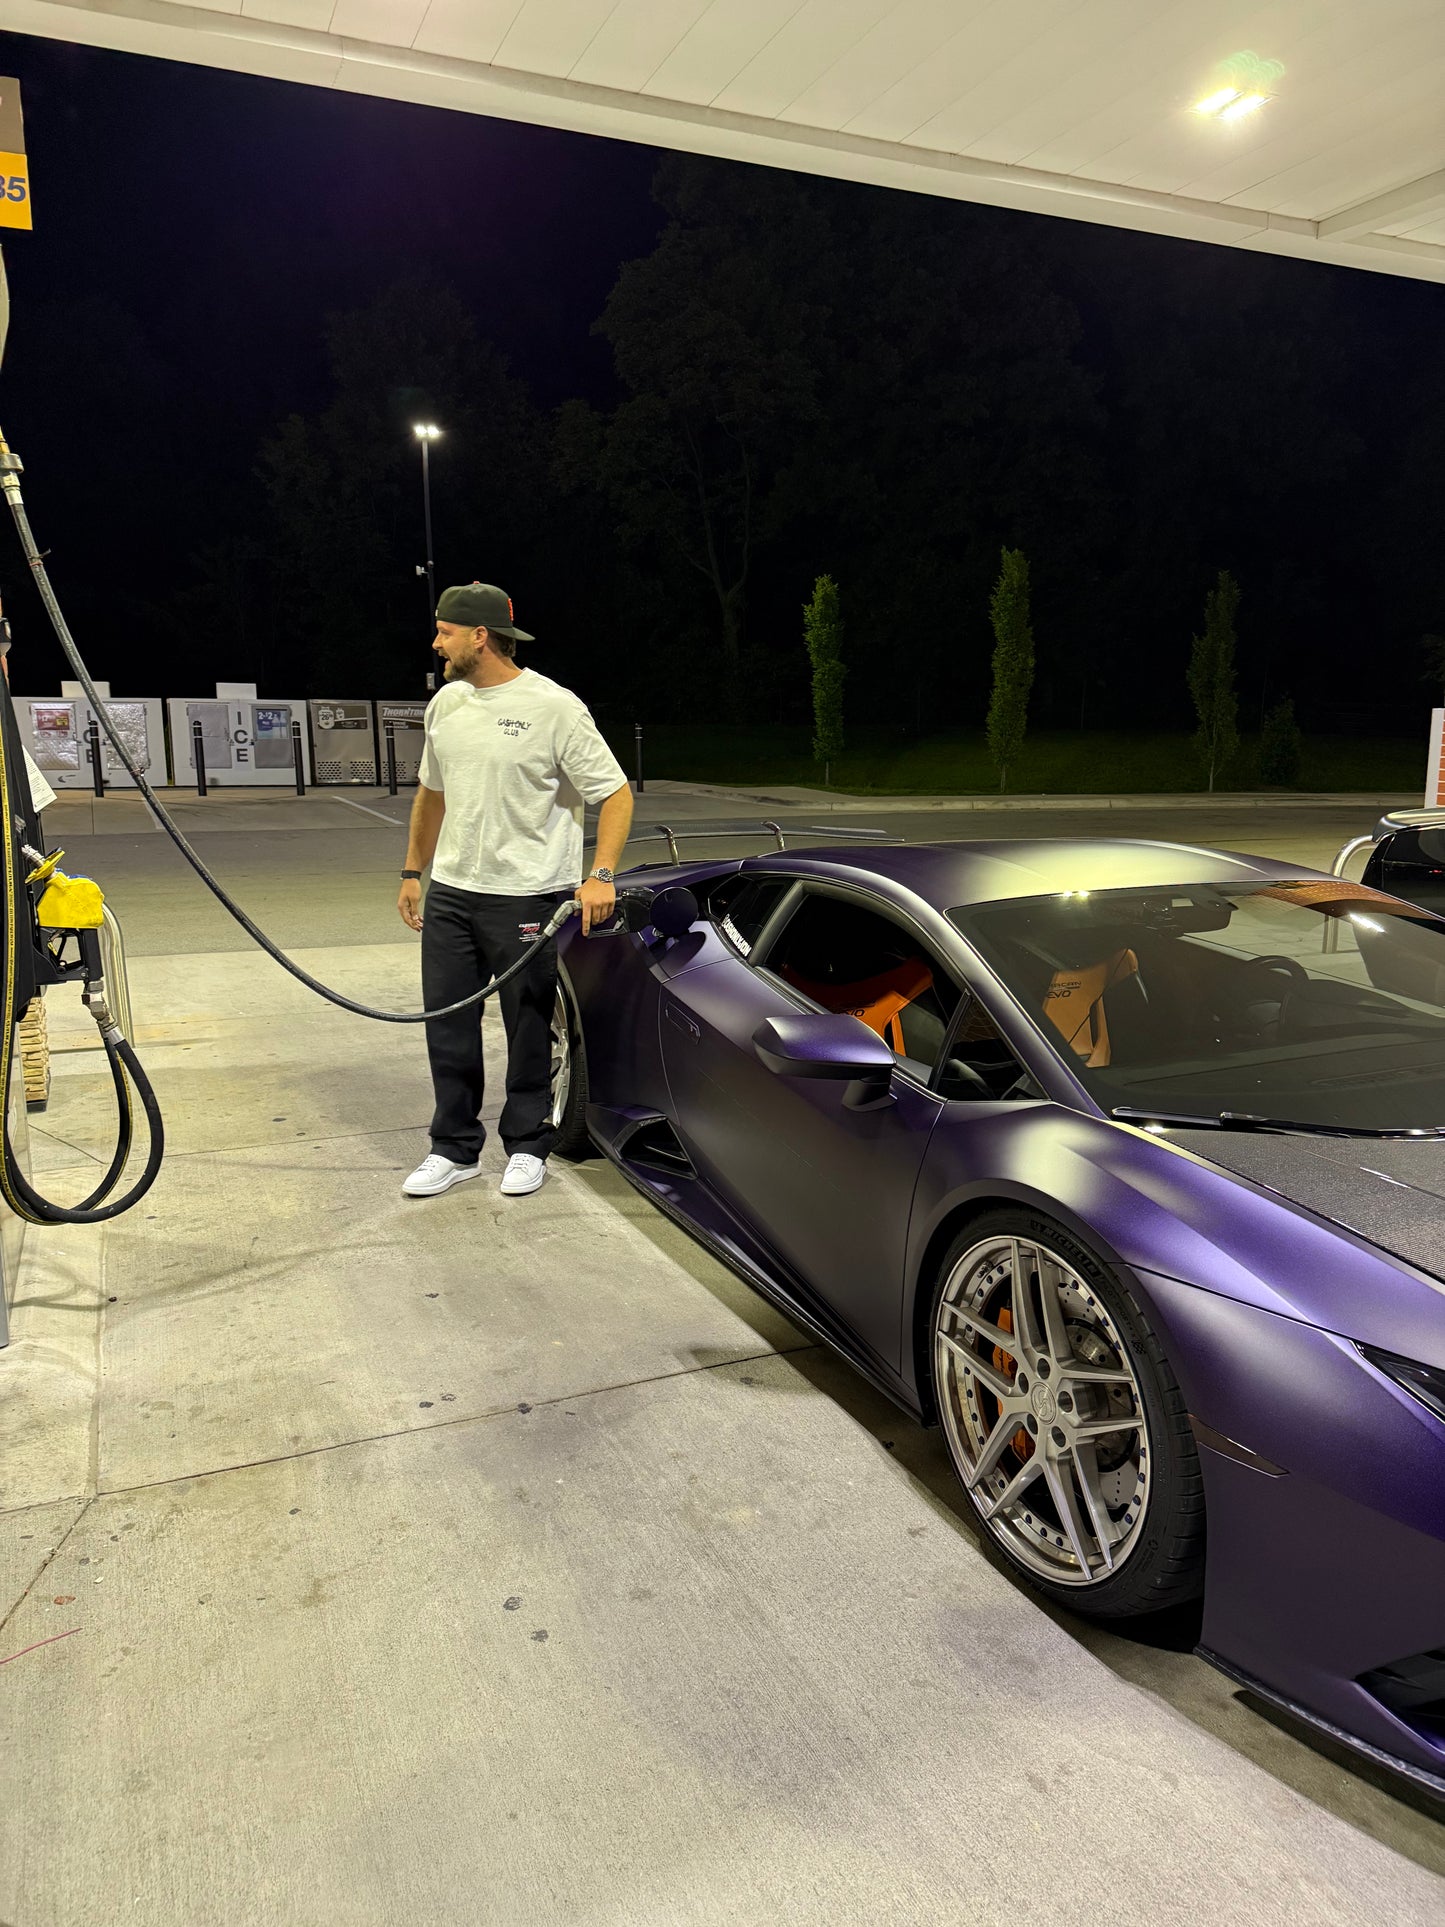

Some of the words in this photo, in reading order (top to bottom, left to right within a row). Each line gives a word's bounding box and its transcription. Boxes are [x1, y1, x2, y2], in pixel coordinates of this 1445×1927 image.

[234, 711, 249, 762] ICE
[1047, 989, 1072, 999] EVO
[1042, 1225, 1101, 1279] MICHELIN
